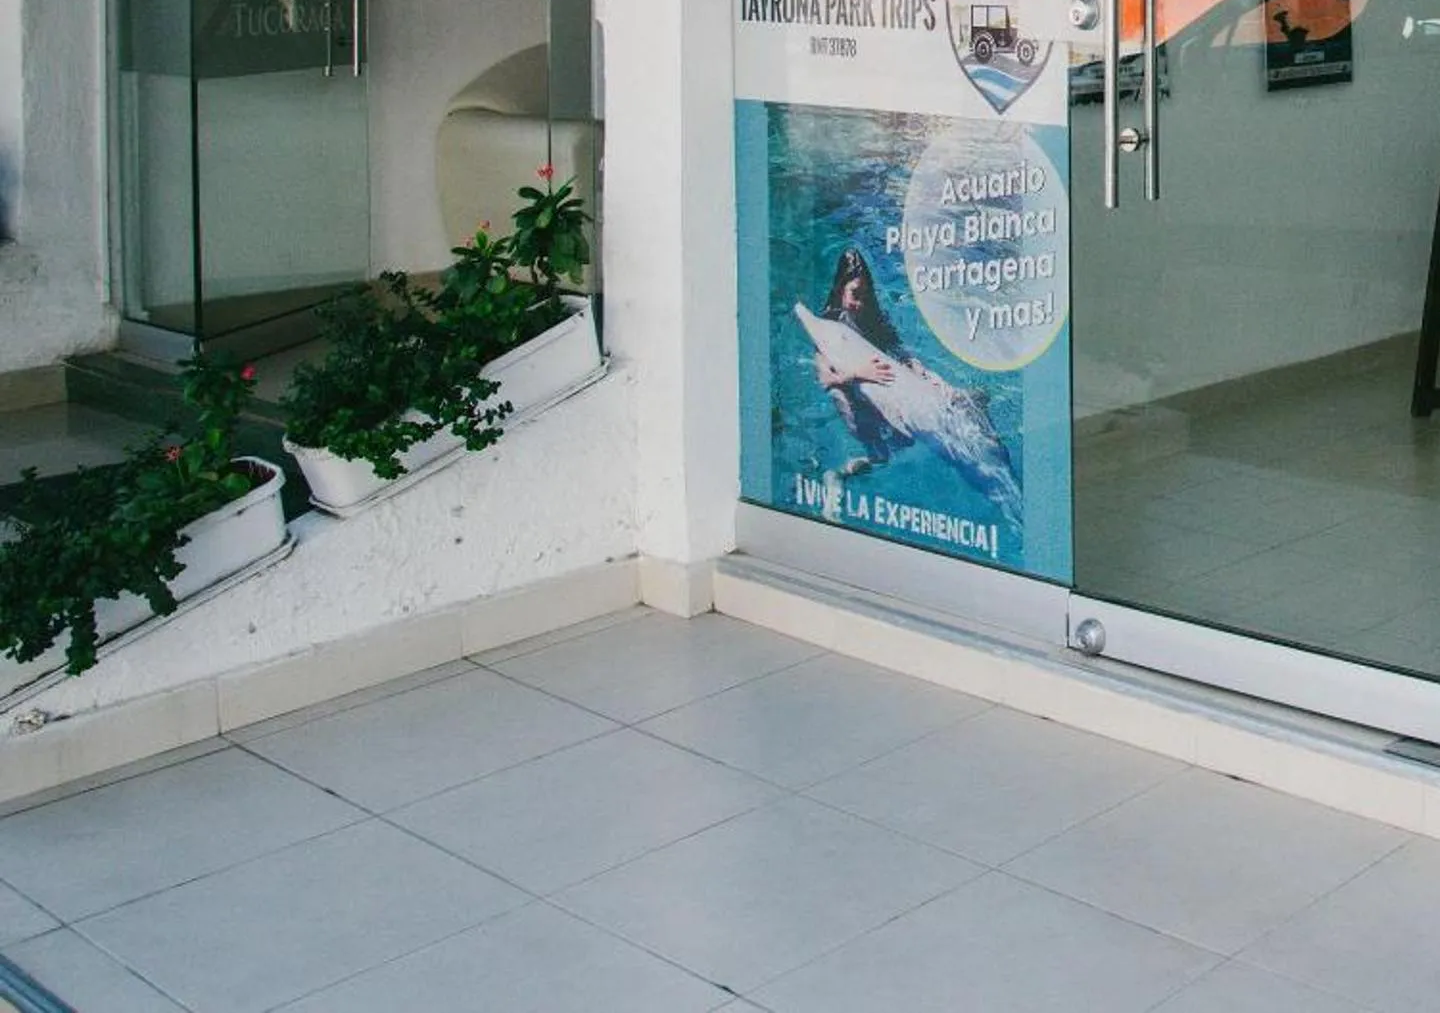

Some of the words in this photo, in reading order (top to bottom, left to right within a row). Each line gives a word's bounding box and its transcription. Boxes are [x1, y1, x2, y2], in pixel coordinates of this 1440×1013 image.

[941, 159, 1047, 206] Acuario
[886, 222, 957, 255] Playa
[964, 207, 1057, 244] Blanca
[914, 251, 1057, 292] Cartagena
[965, 307, 982, 340] y
[846, 490, 870, 521] LA
[874, 496, 999, 559] EXPERIENCIA!
